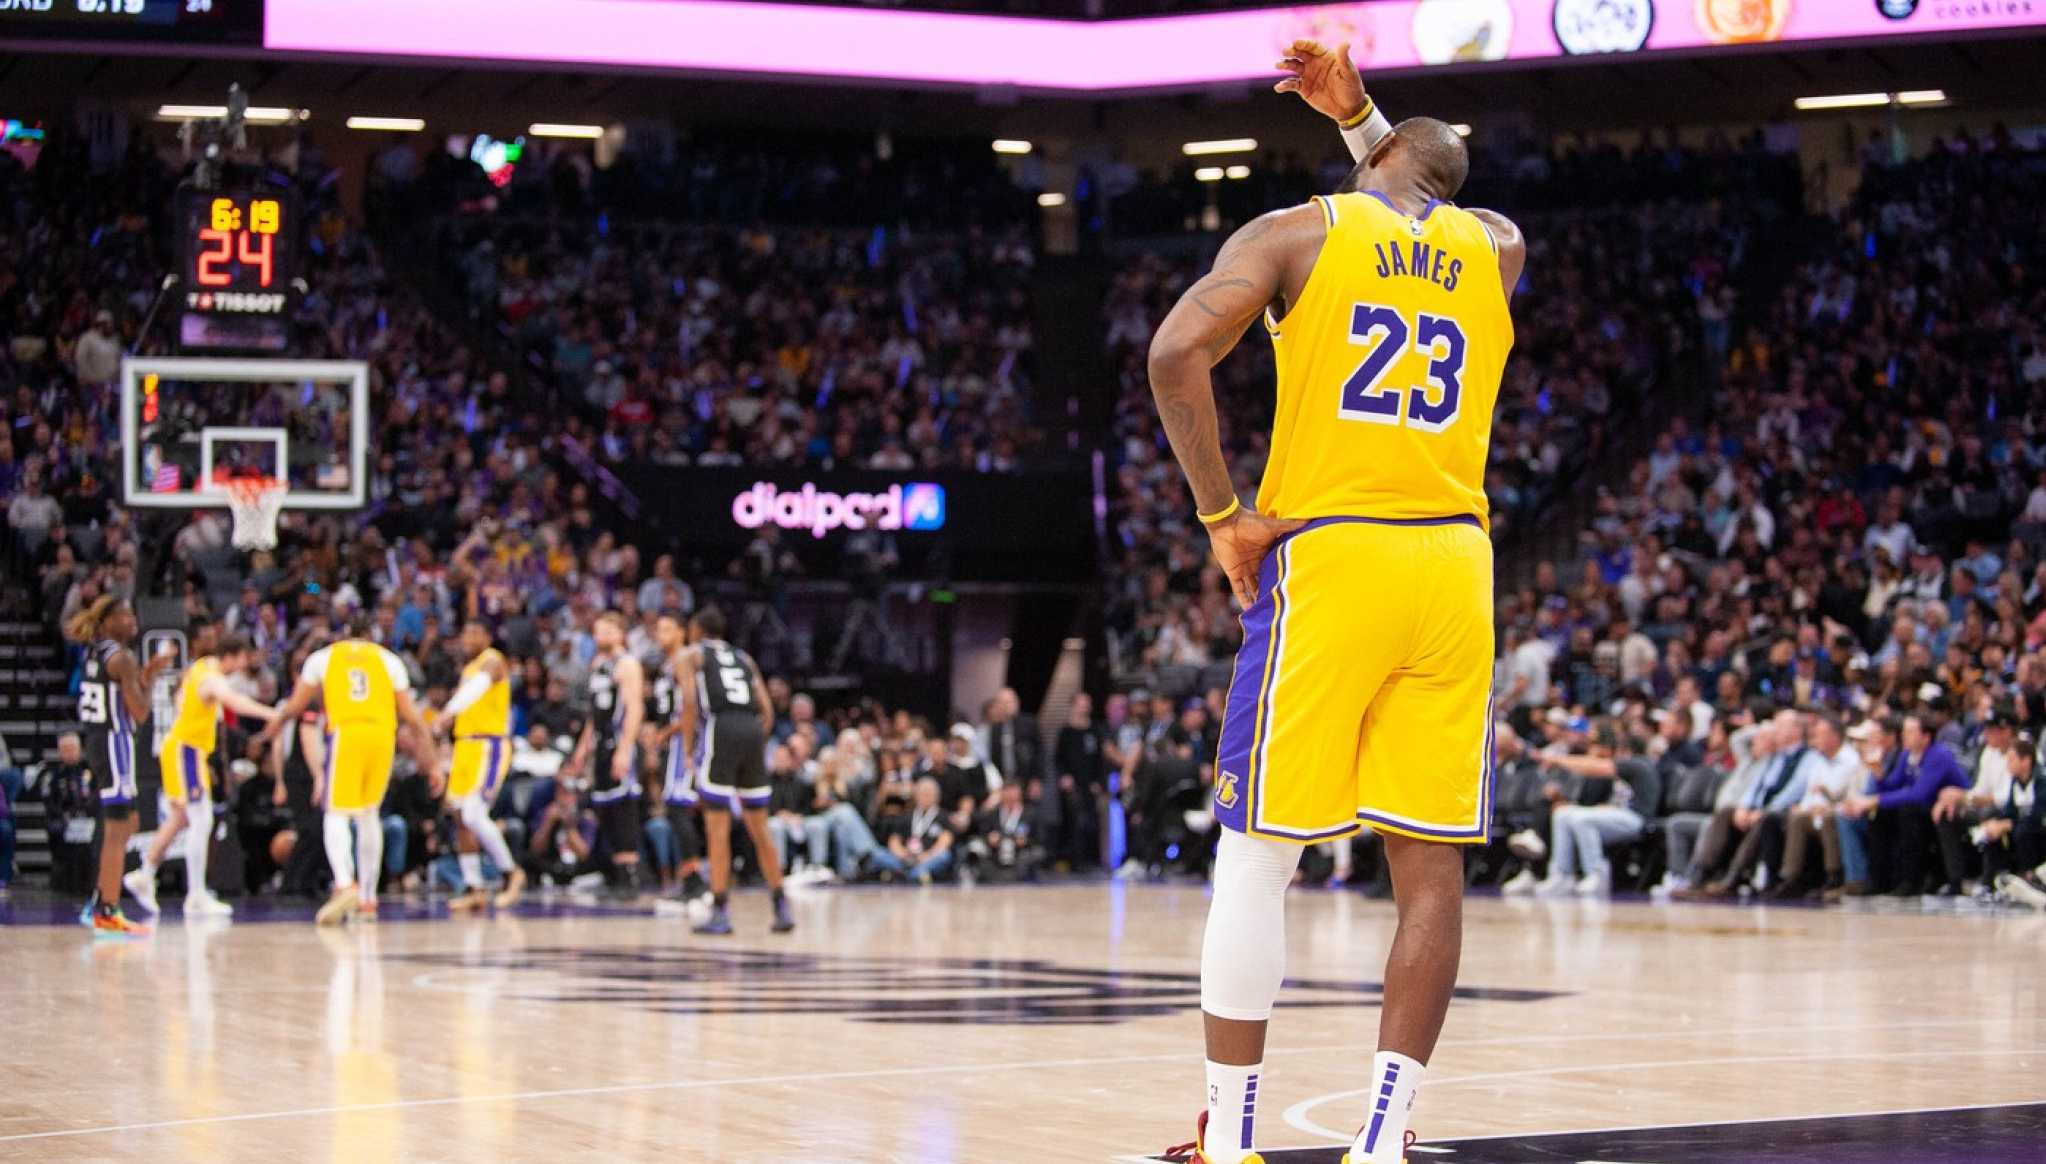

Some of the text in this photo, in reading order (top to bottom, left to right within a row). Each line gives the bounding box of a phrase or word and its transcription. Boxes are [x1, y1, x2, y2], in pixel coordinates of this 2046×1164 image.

[211, 198, 280, 233] 6:19
[199, 229, 272, 287] 24
[1374, 240, 1463, 292] JAMES
[1337, 301, 1468, 434] 23
[732, 481, 903, 539] dialpad
[348, 668, 370, 701] 3
[719, 667, 750, 705] 5
